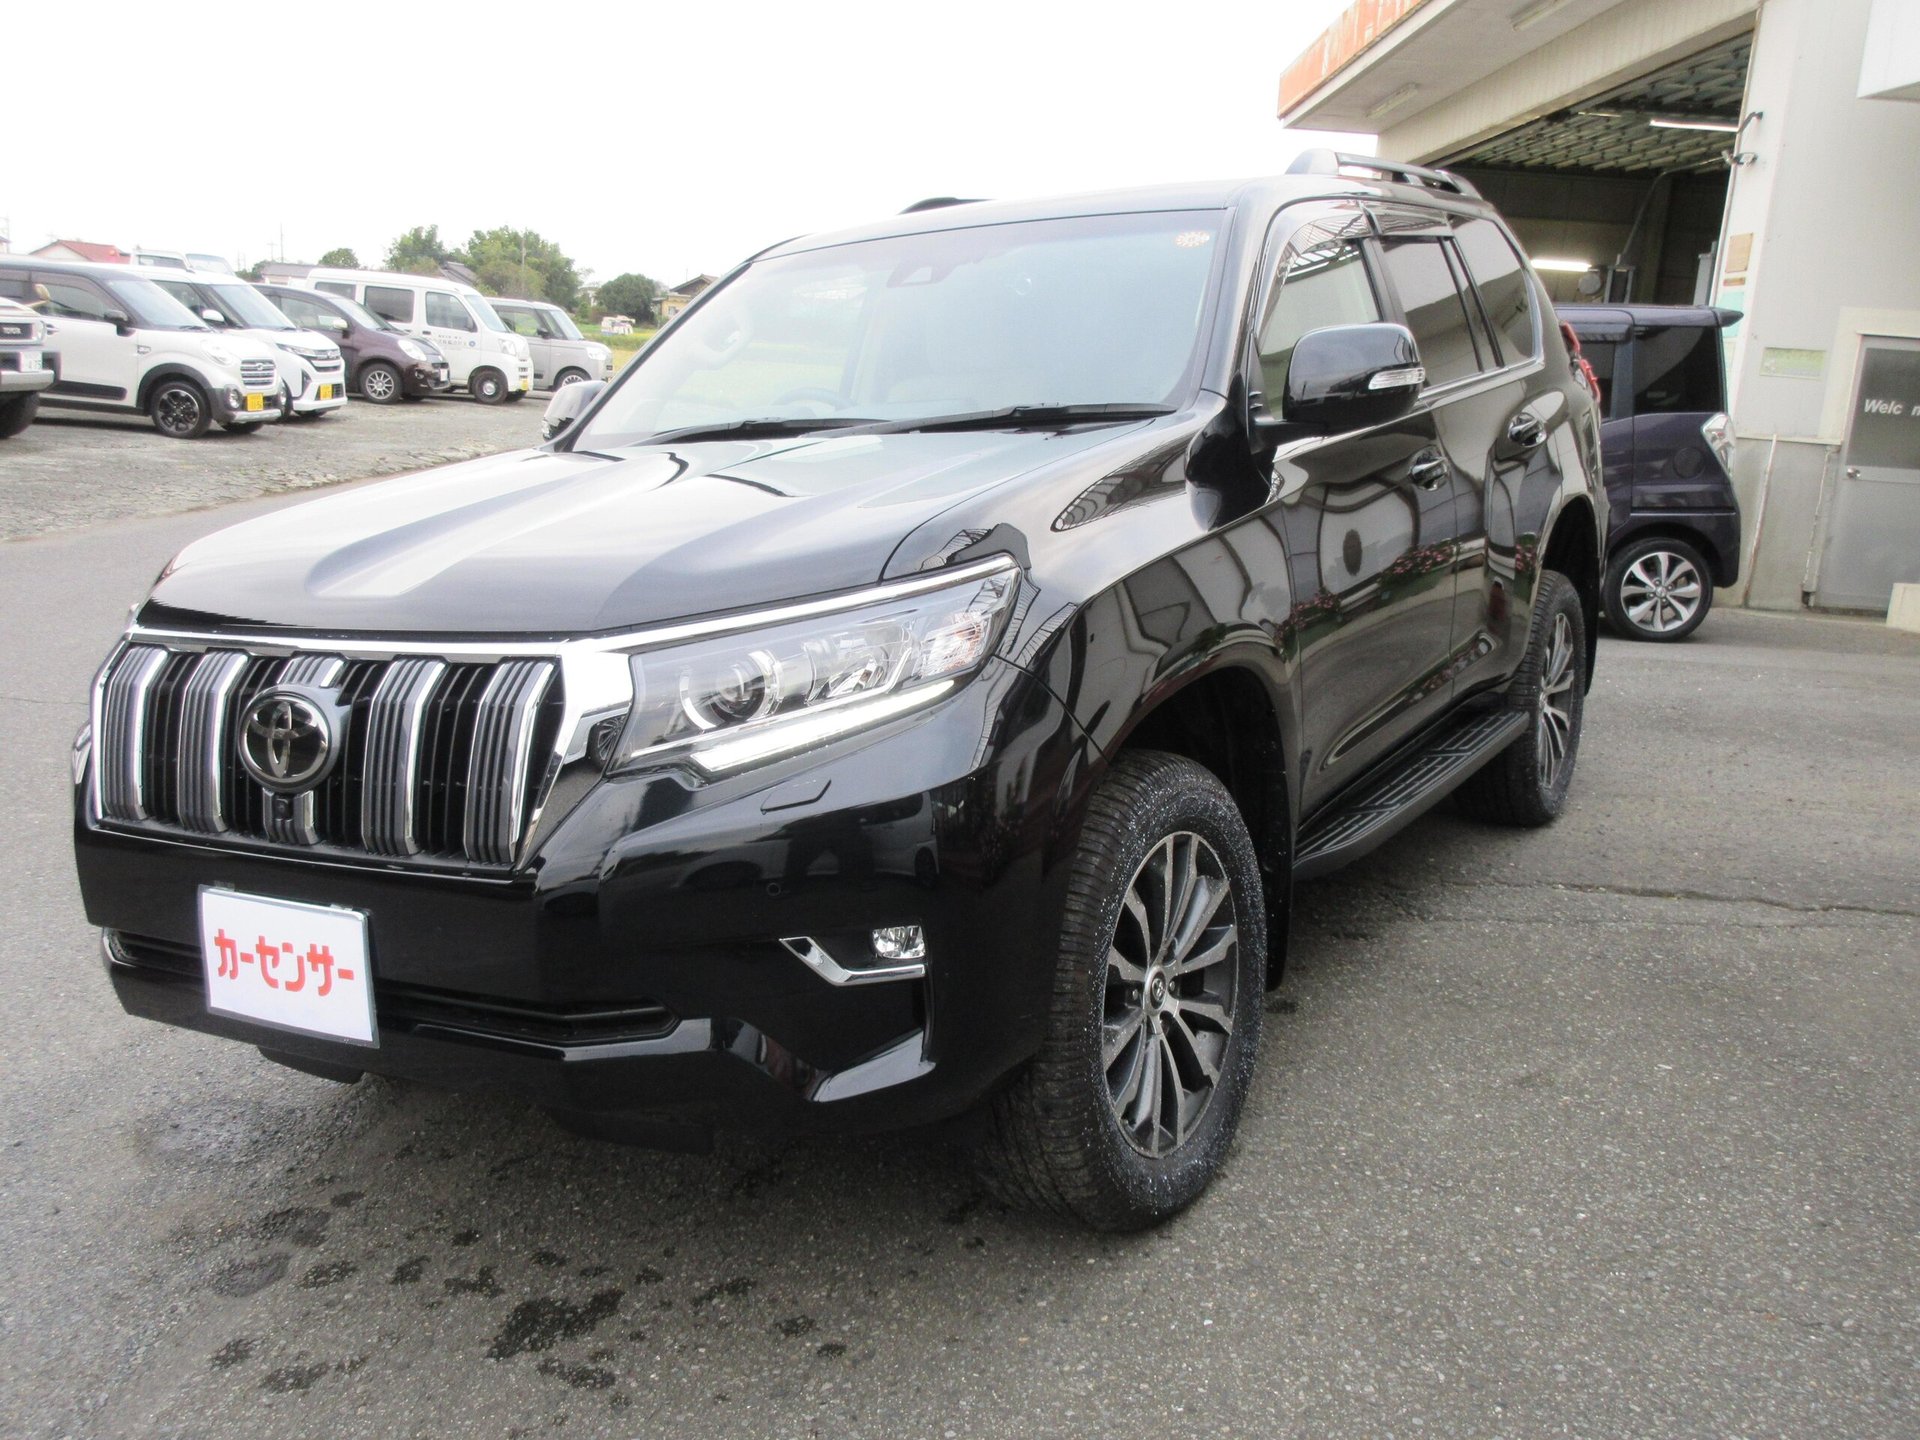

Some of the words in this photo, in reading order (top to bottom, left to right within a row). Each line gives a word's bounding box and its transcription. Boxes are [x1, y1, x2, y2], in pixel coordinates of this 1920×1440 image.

[214, 928, 354, 996] カーセンサー
